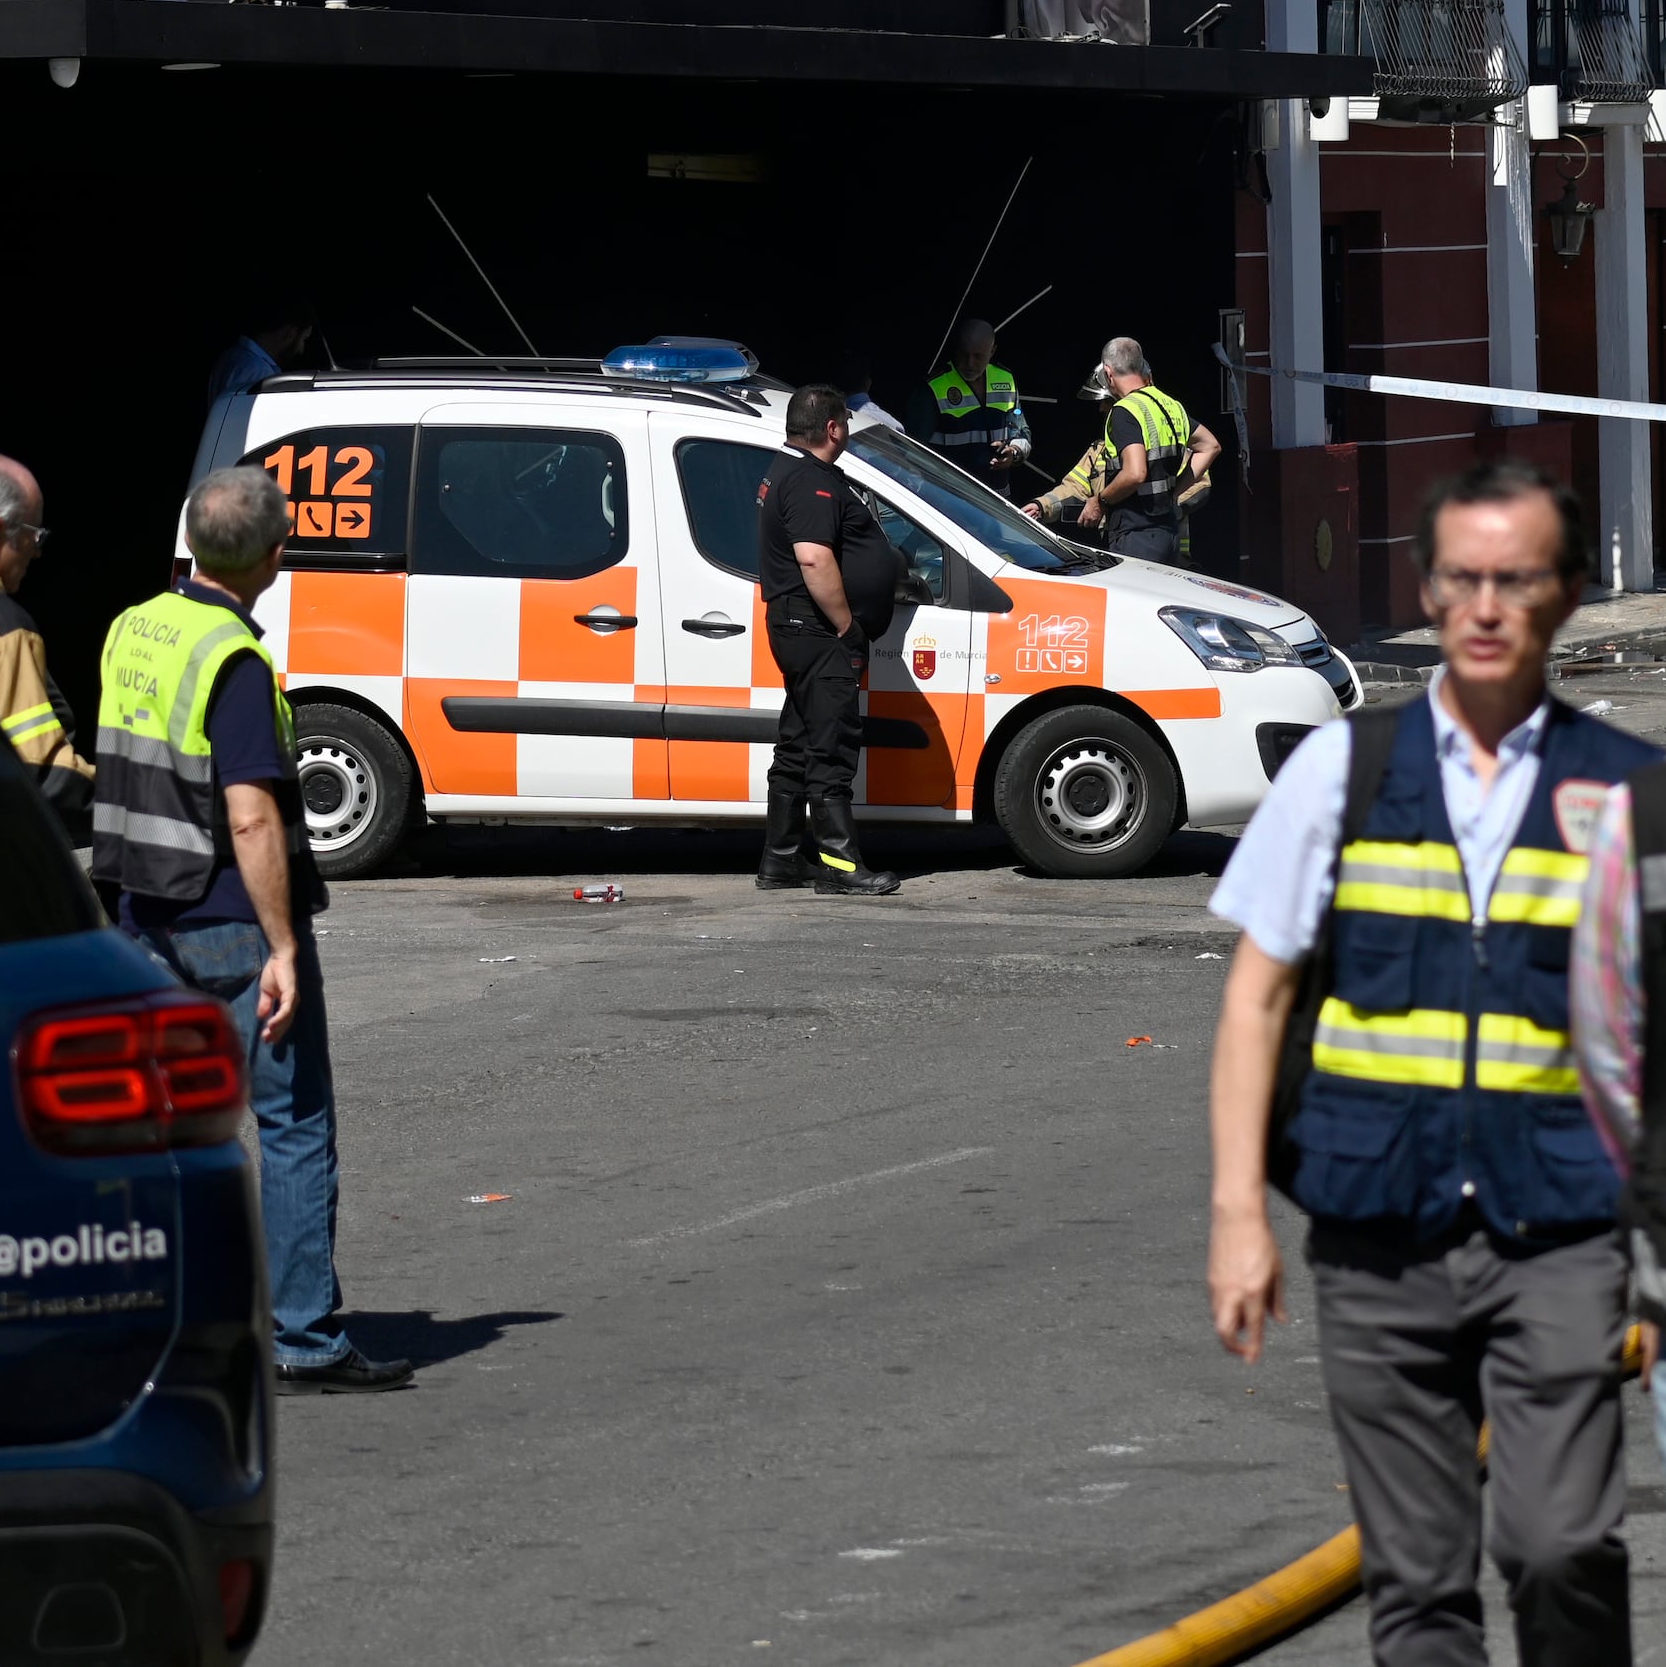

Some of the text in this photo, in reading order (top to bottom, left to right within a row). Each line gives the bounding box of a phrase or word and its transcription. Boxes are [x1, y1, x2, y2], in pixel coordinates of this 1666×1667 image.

[264, 444, 374, 497] 112
[129, 615, 182, 648] POLICIA
[1019, 613, 1089, 648] 112
[129, 647, 154, 662] LOAL
[939, 650, 952, 660] de
